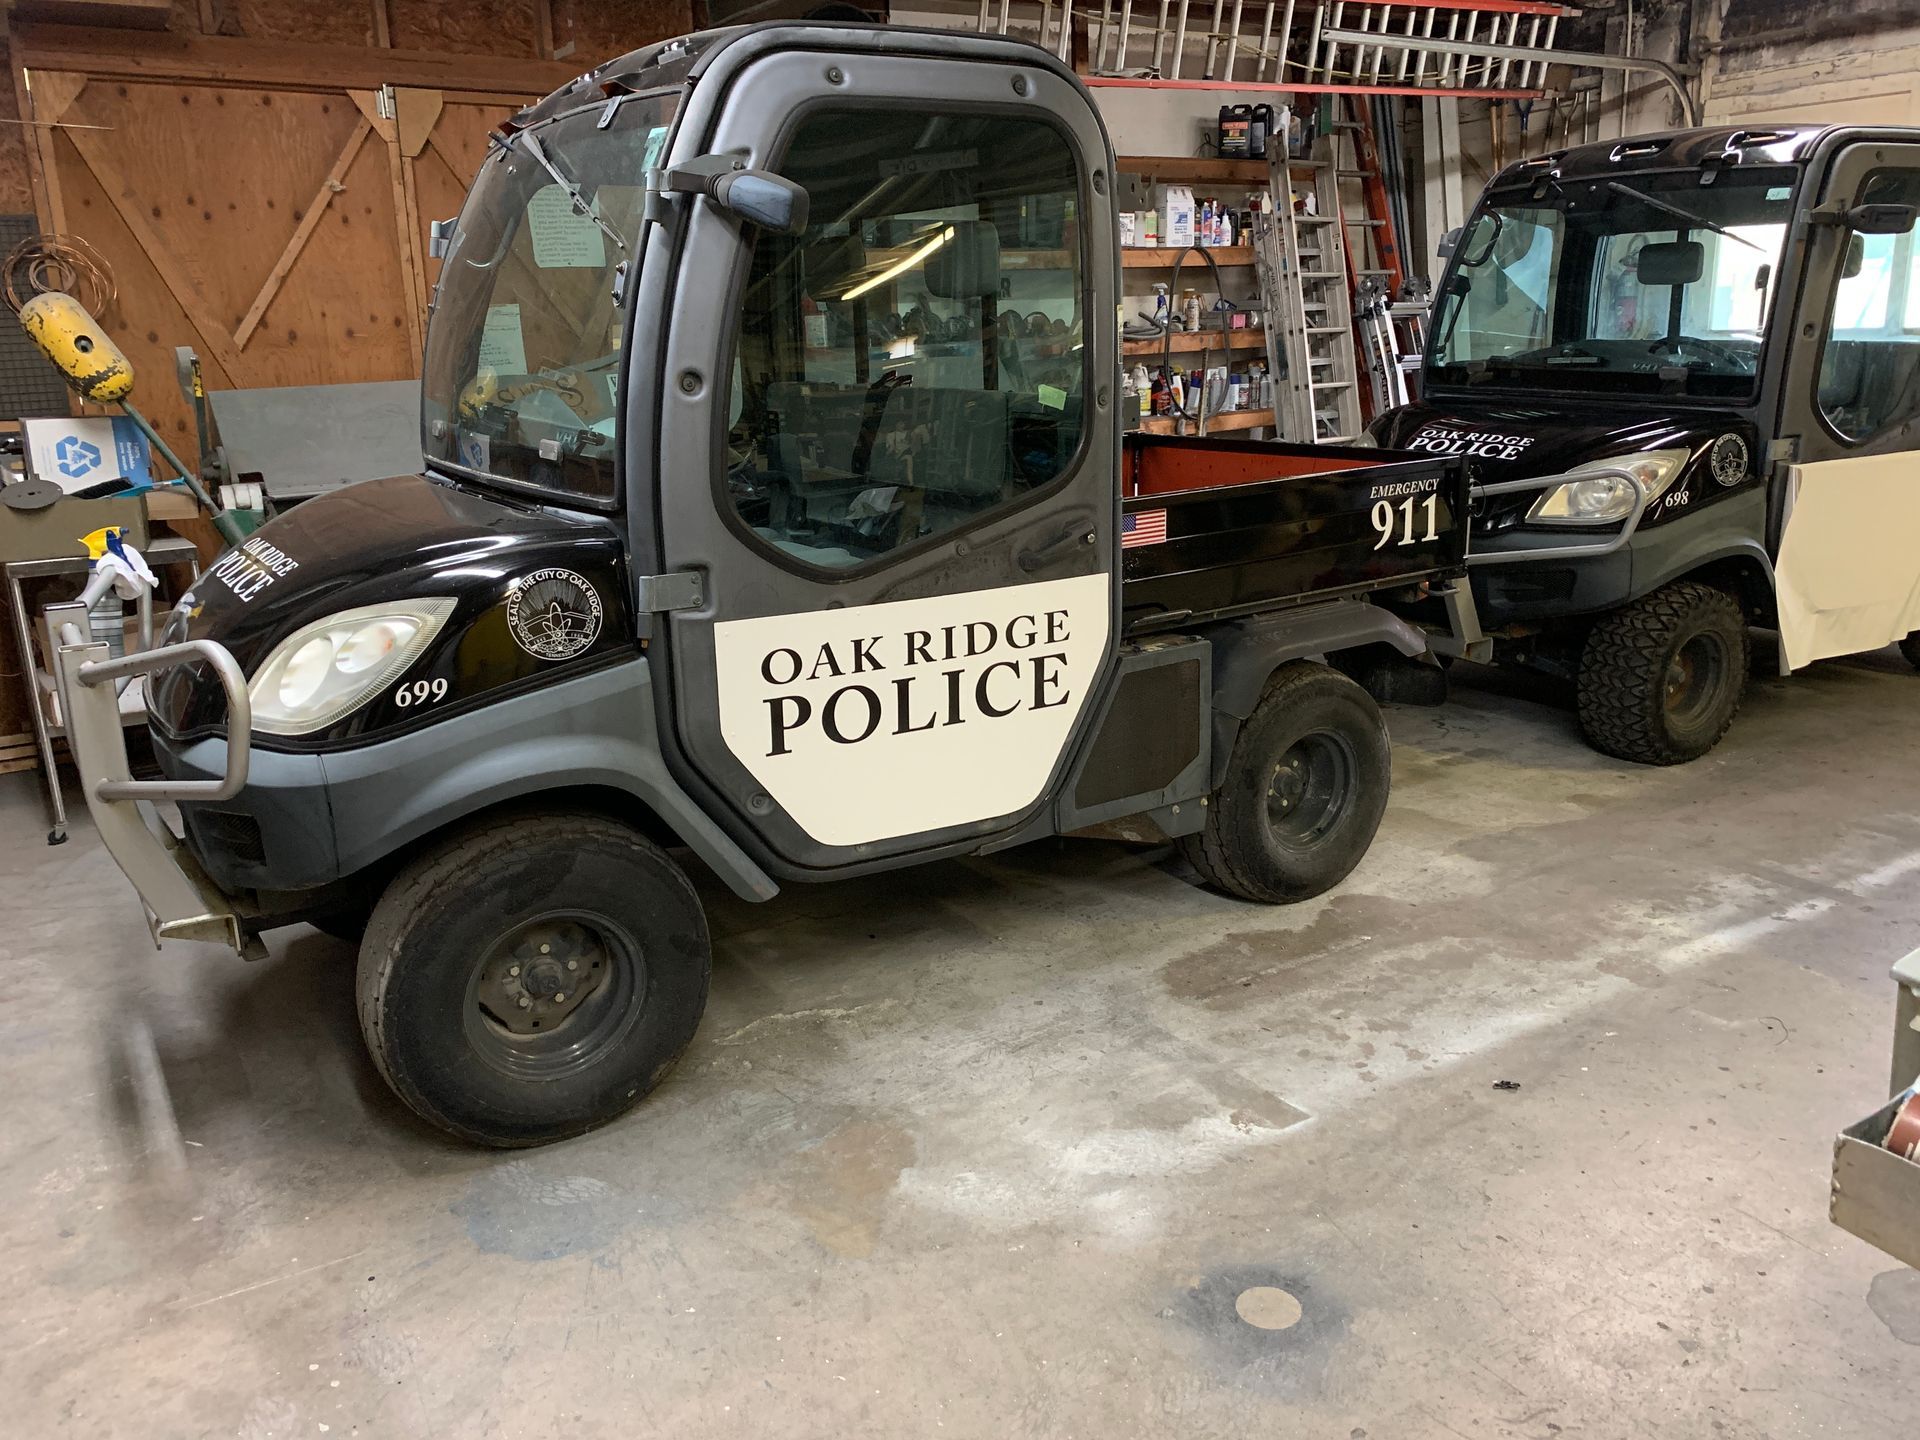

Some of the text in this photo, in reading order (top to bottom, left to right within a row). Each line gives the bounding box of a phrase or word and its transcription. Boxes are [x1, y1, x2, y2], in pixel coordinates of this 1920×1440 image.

[1405, 437, 1524, 460] POLICE
[1421, 429, 1534, 447] OAK RIDGE
[1370, 478, 1440, 499] EMERGENCY
[1665, 490, 1689, 507] 698
[1371, 492, 1439, 551] 911
[210, 550, 275, 603] POLICE
[242, 537, 299, 577] OAK RIDGE
[509, 570, 601, 626] SEAL OF THE CITY OF OAK RIDGE
[761, 609, 1072, 685] OAK RIDGE
[395, 678, 448, 707] 699
[762, 652, 1071, 757] POLICE
